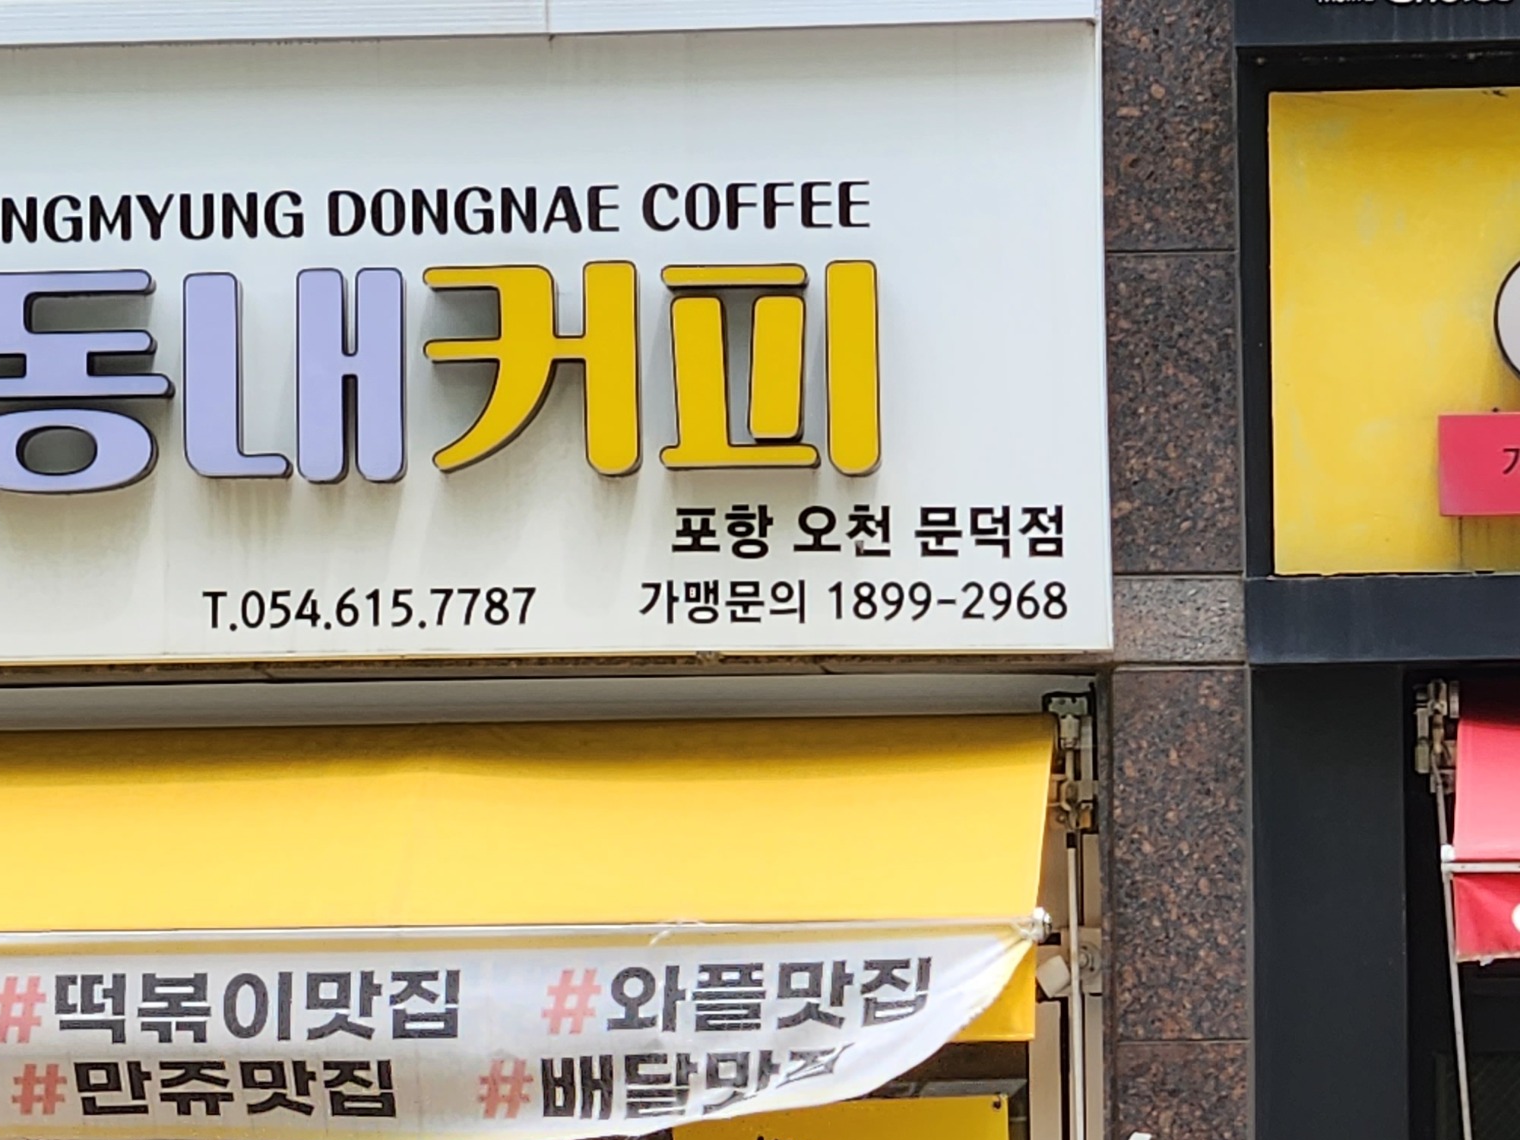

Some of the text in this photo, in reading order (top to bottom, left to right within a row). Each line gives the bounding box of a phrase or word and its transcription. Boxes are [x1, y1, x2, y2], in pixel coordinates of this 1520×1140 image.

[327, 184, 620, 237] DONGNAE
[641, 180, 871, 232] COFFEE
[671, 503, 1067, 559] 포항 오천 문덕점
[202, 587, 536, 632] T.054.615.7787
[640, 580, 1069, 625] 가맹문의 1899-2968
[541, 957, 933, 1035] #와플맛집
[11, 1059, 397, 1118] #만쥬맛집
